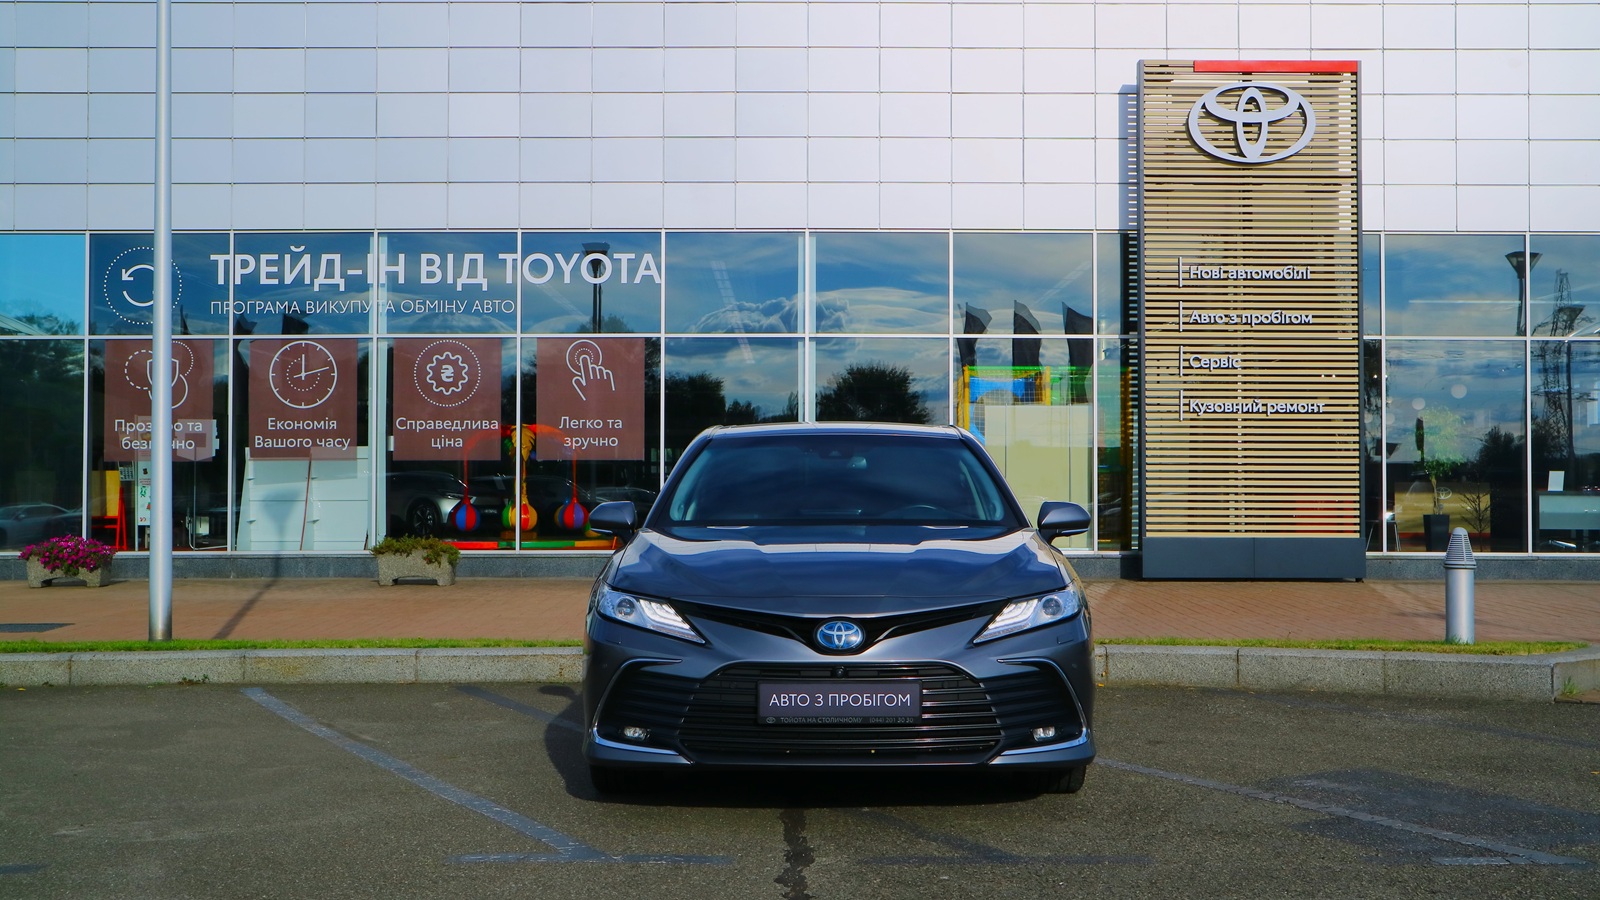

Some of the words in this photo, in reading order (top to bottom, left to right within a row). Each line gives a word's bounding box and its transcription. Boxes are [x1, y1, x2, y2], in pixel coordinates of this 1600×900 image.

[210, 245, 405, 291] ТРЕЙД-ІН
[420, 253, 488, 291] ВІД
[498, 253, 661, 284] TOYOTA
[1188, 266, 1224, 280] Нові
[1228, 265, 1311, 280] автомобілі
[210, 301, 301, 315] ПРОГРАМА
[305, 300, 373, 314] ВИКУПУ
[400, 299, 467, 313] ОБМІНУ
[471, 299, 515, 313] АВТО
[1188, 310, 1225, 324] Авто
[1229, 313, 1239, 324] з
[1242, 310, 1313, 327] пробігом
[1188, 355, 1242, 371] Сервіс
[1188, 399, 1263, 416] Кузовний
[1267, 401, 1326, 417] ремонт
[114, 419, 183, 435] Прозо
[187, 421, 203, 432] та
[267, 417, 337, 430] Економія
[395, 417, 499, 432] Справедлива
[559, 416, 603, 429] Легко
[607, 419, 623, 429] та
[254, 435, 312, 448] Вашого
[316, 437, 351, 451] часу
[431, 435, 463, 448] ціна
[563, 437, 619, 450] зручно
[769, 693, 810, 707] АВТО
[814, 693, 824, 707] З
[828, 693, 911, 707] ПРОБІГОМ
[780, 716, 806, 724] ТОЙОТА
[817, 716, 863, 724] СТОЛИЧНОМУ
